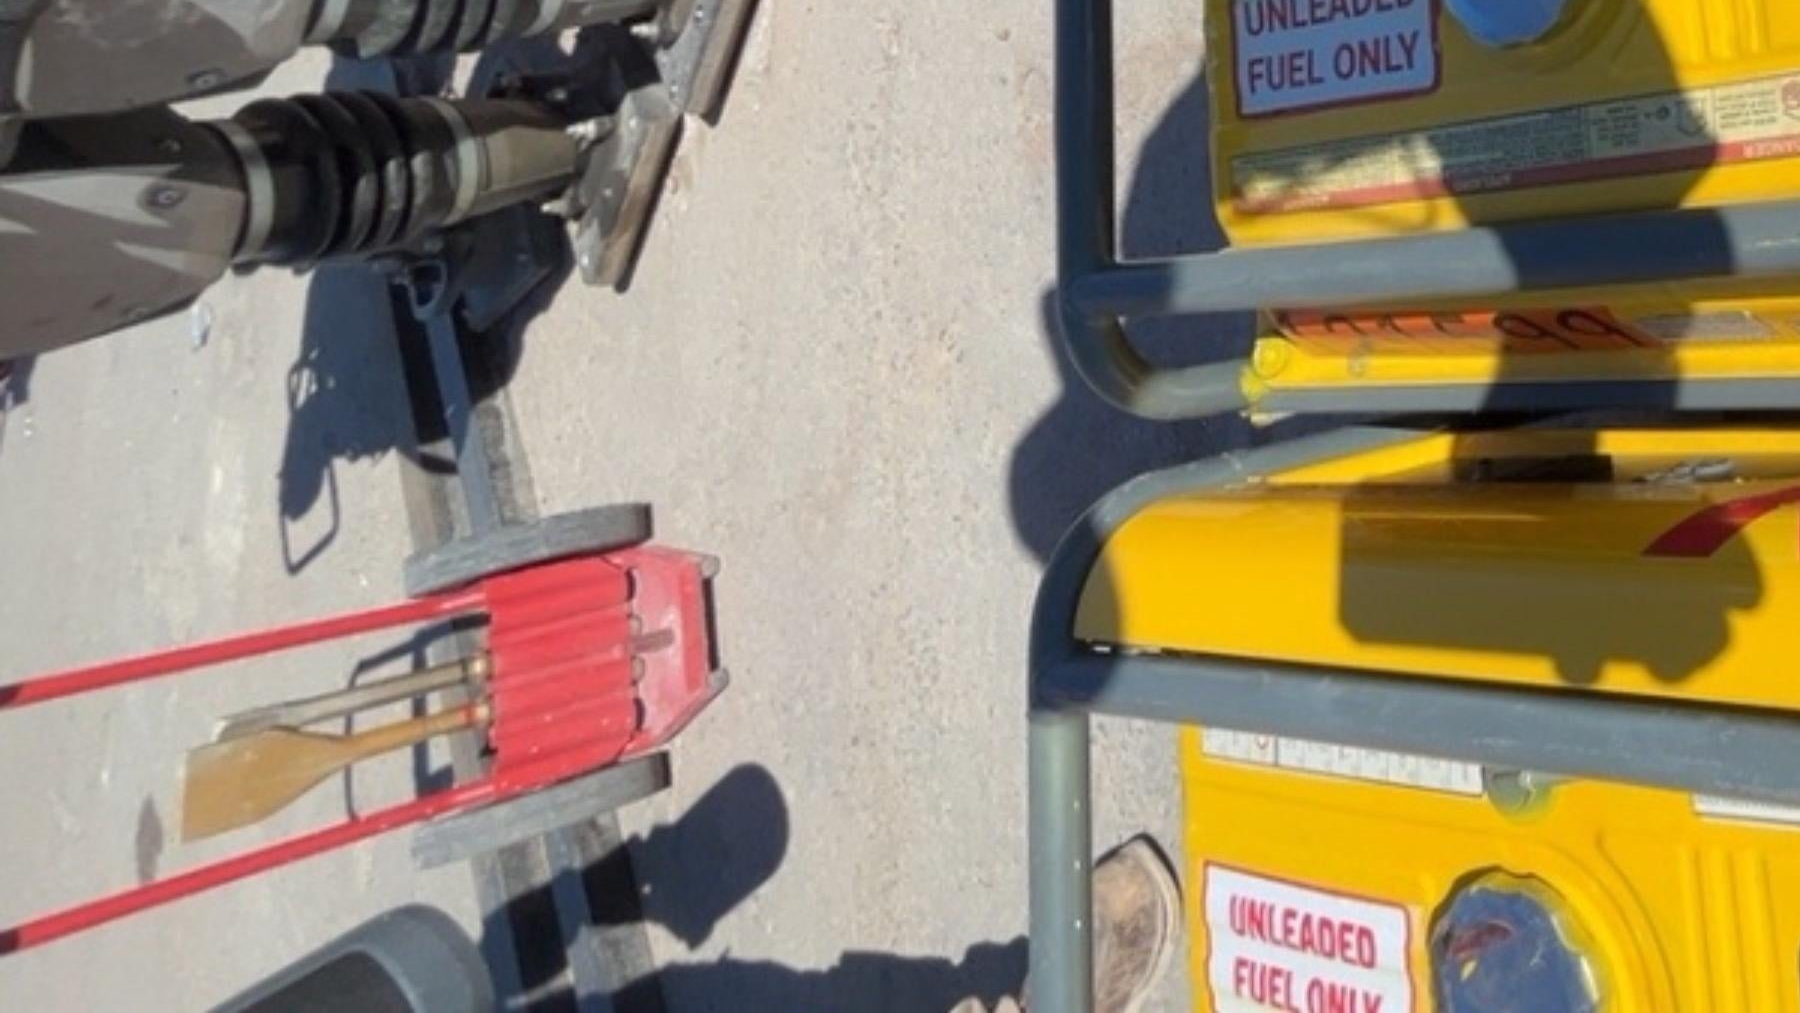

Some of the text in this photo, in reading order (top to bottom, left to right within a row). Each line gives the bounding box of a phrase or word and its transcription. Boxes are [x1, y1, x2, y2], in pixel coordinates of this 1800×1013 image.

[1248, 29, 1420, 95] FUEL ONLY
[1229, 894, 1376, 969] UNLEADED
[1234, 956, 1300, 1013] FUEL
